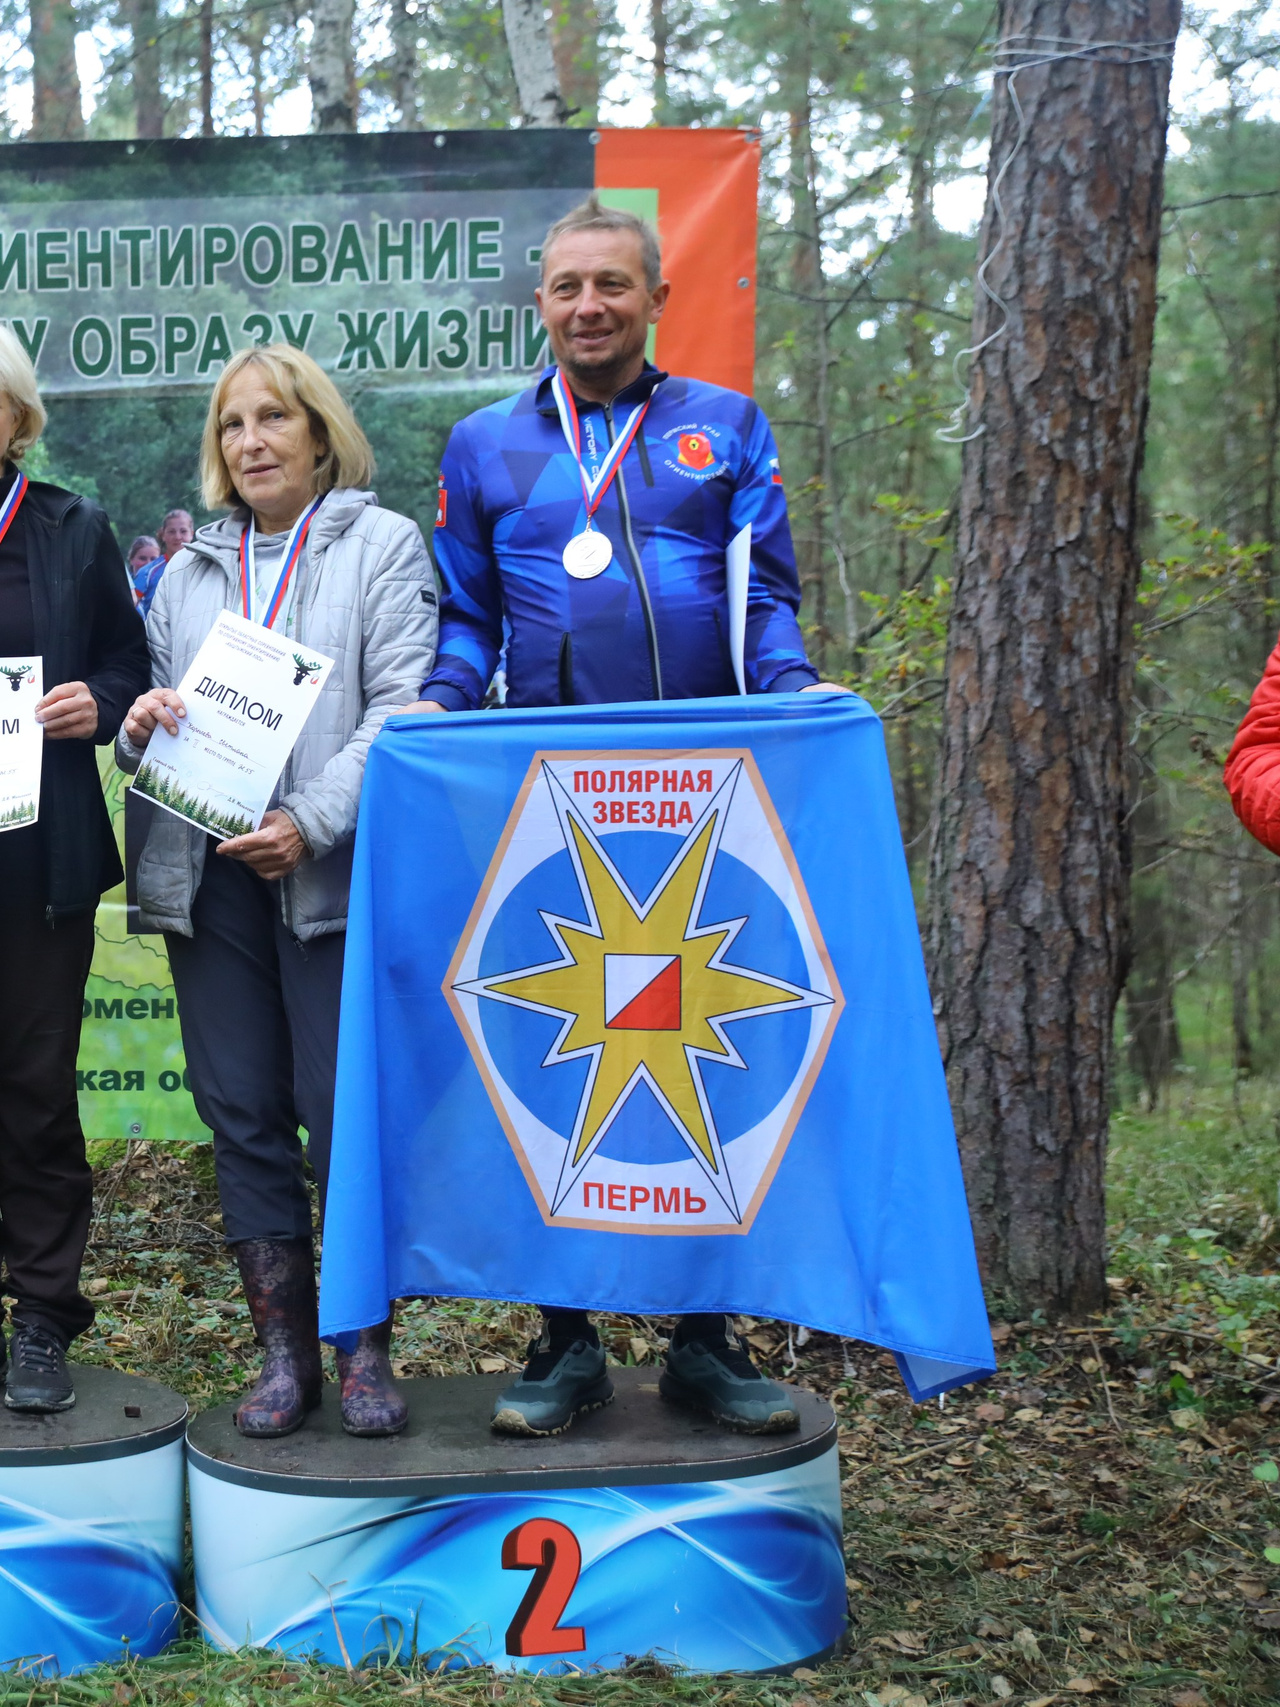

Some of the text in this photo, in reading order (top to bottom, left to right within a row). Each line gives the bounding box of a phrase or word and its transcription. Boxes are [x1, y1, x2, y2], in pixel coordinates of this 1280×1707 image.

[336, 306, 553, 371] ЖИЗНИ
[583, 416, 598, 461] VICTORY
[194, 676, 283, 731] ДИПЛОМ
[573, 769, 713, 793] ПОЛЯРНАЯ
[593, 800, 694, 826] ЗВЕЗДА
[582, 1182, 707, 1214] ПЕРМЬ
[501, 1517, 587, 1657] 2
